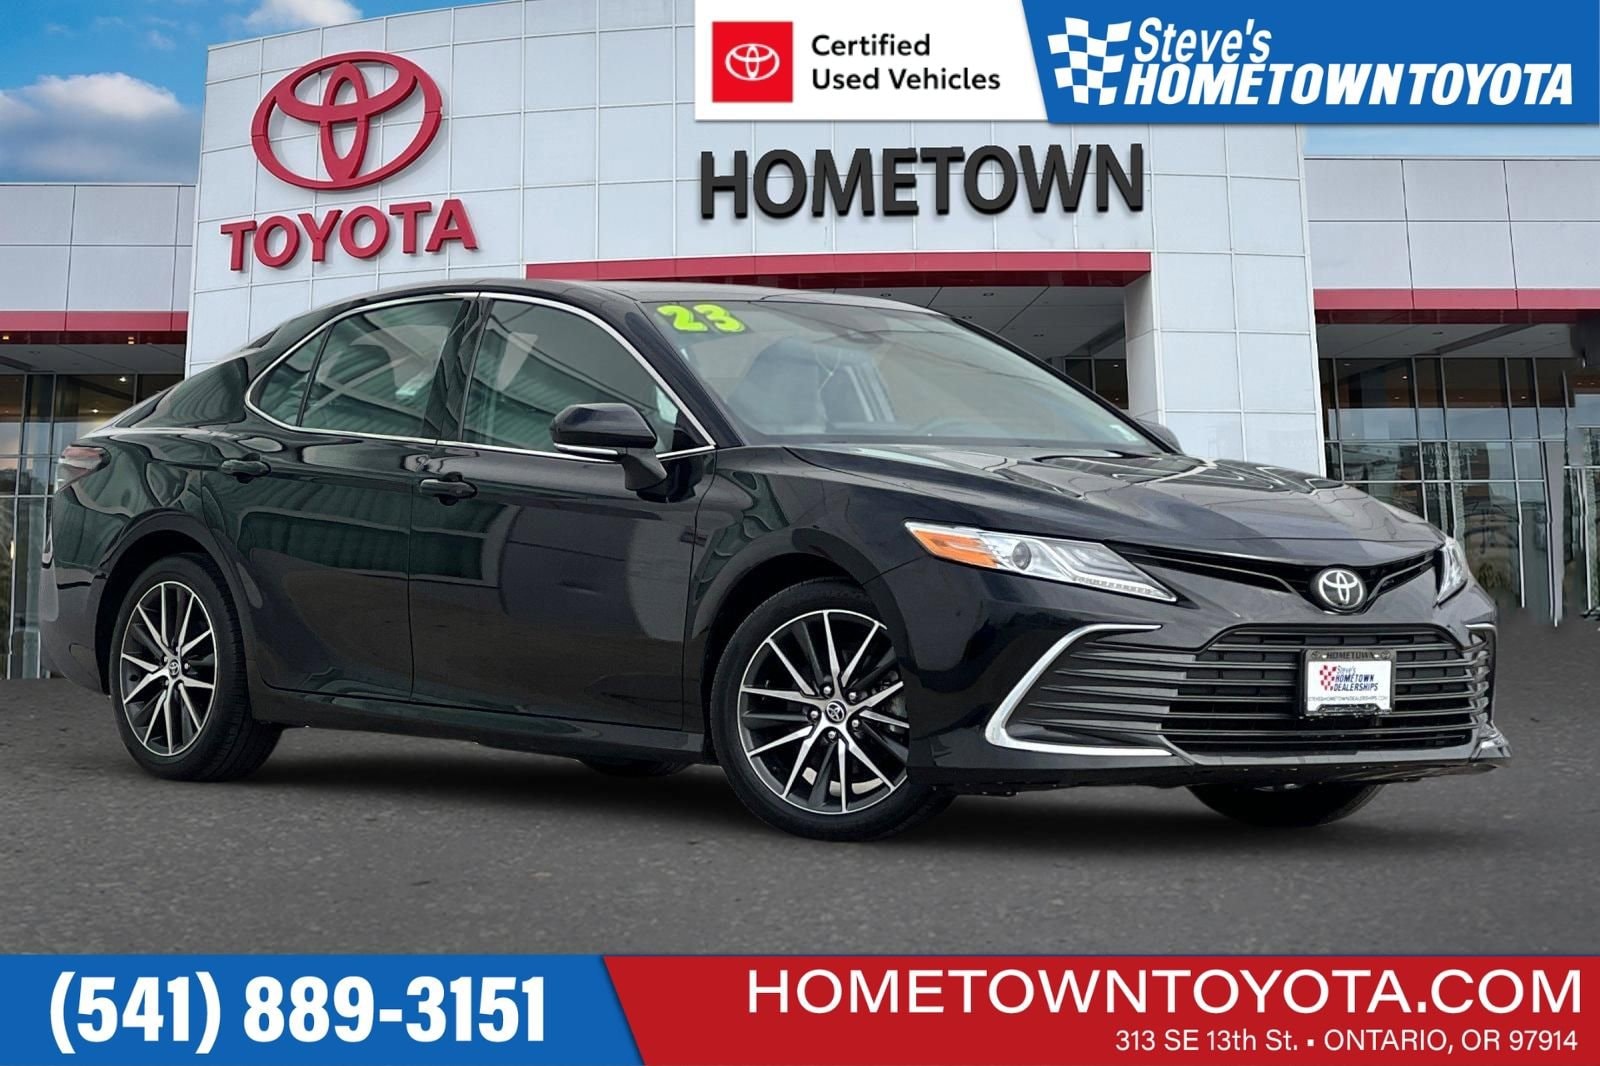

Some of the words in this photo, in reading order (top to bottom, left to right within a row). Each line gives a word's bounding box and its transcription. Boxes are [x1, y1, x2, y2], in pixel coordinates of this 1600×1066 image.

[700, 143, 1146, 221] HOMETOWN
[221, 198, 478, 271] TOYOTA
[656, 303, 746, 333] 23
[1326, 651, 1375, 659] HOMETOWN
[1336, 665, 1357, 674] Steve's
[1335, 674, 1375, 682] HOMETOWN
[1334, 683, 1378, 691] DEALERSHIPS
